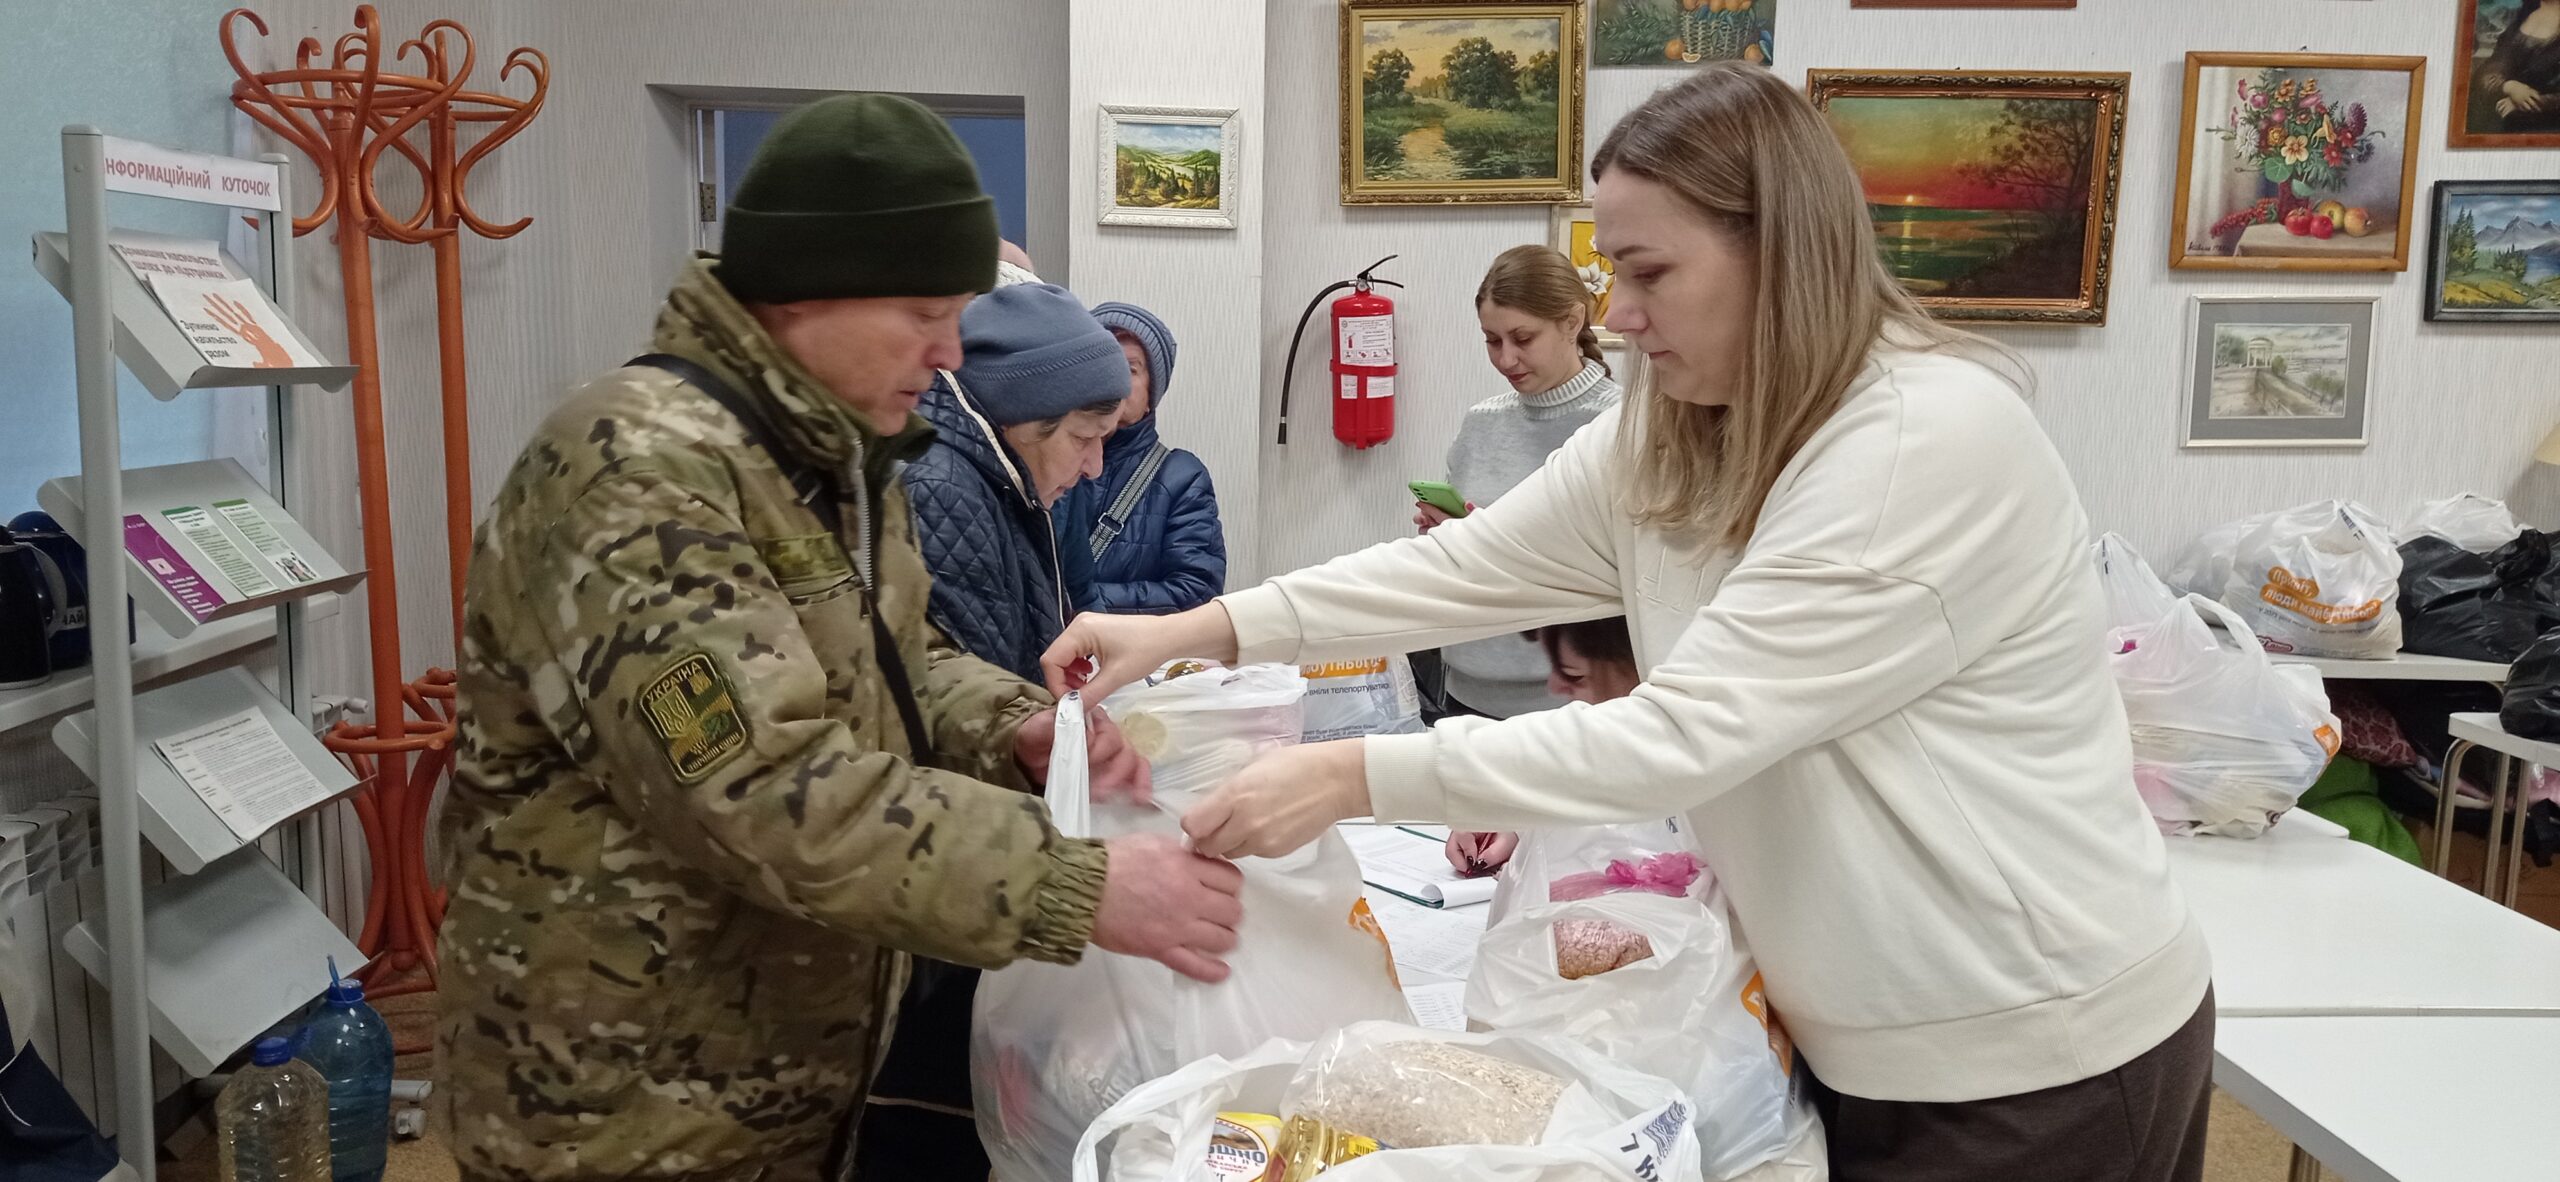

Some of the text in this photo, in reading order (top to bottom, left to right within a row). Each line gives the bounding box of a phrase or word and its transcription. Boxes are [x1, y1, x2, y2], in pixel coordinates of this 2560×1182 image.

[105, 158, 271, 197] НФОРМАЦІЙНИЙ КУТОЧОК
[2272, 568, 2314, 596] Привіт,
[2264, 587, 2299, 608] люди
[646, 661, 701, 701] УКРАЇНА
[1309, 687, 1330, 696] вміли
